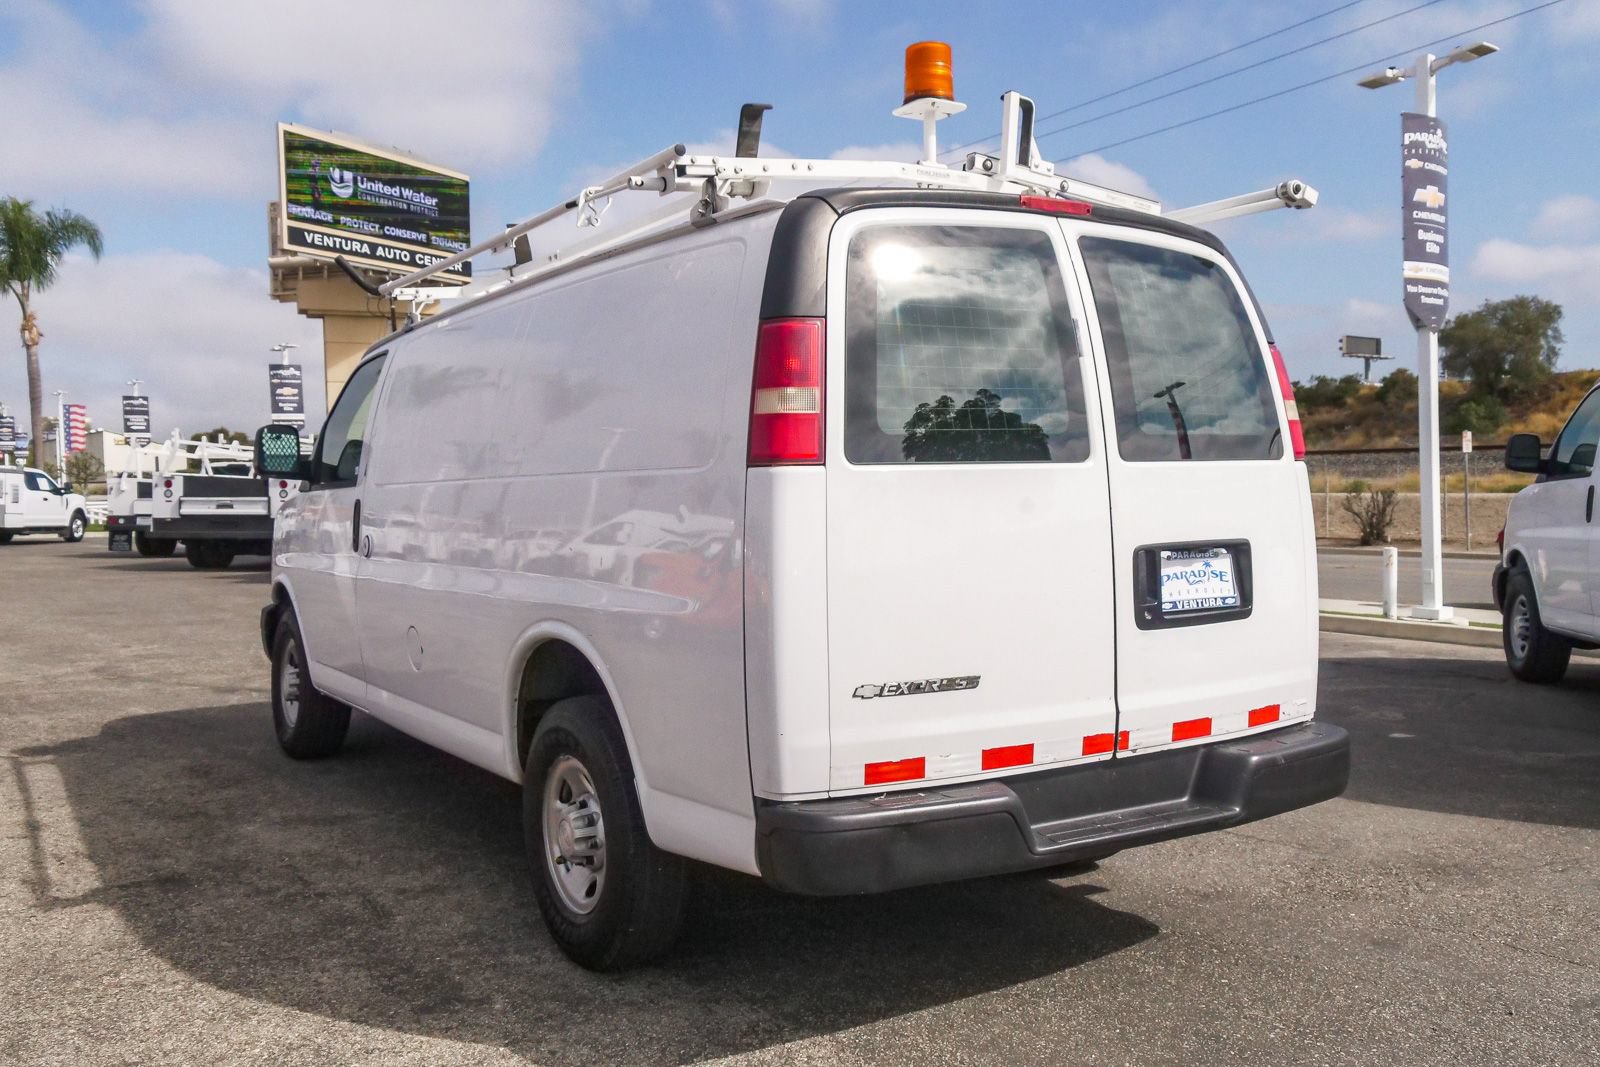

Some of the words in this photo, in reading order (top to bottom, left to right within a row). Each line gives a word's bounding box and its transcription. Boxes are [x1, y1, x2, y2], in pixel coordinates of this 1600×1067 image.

[357, 176, 400, 196] United
[401, 187, 438, 205] Water
[340, 216, 380, 232] PROTECT
[384, 226, 427, 242] CONSERVE
[304, 231, 370, 255] VENTURA
[375, 246, 410, 262] AUTO
[1171, 549, 1215, 560] PARADISE
[1159, 562, 1229, 587] PARADISE
[1176, 598, 1223, 609] VENTURA
